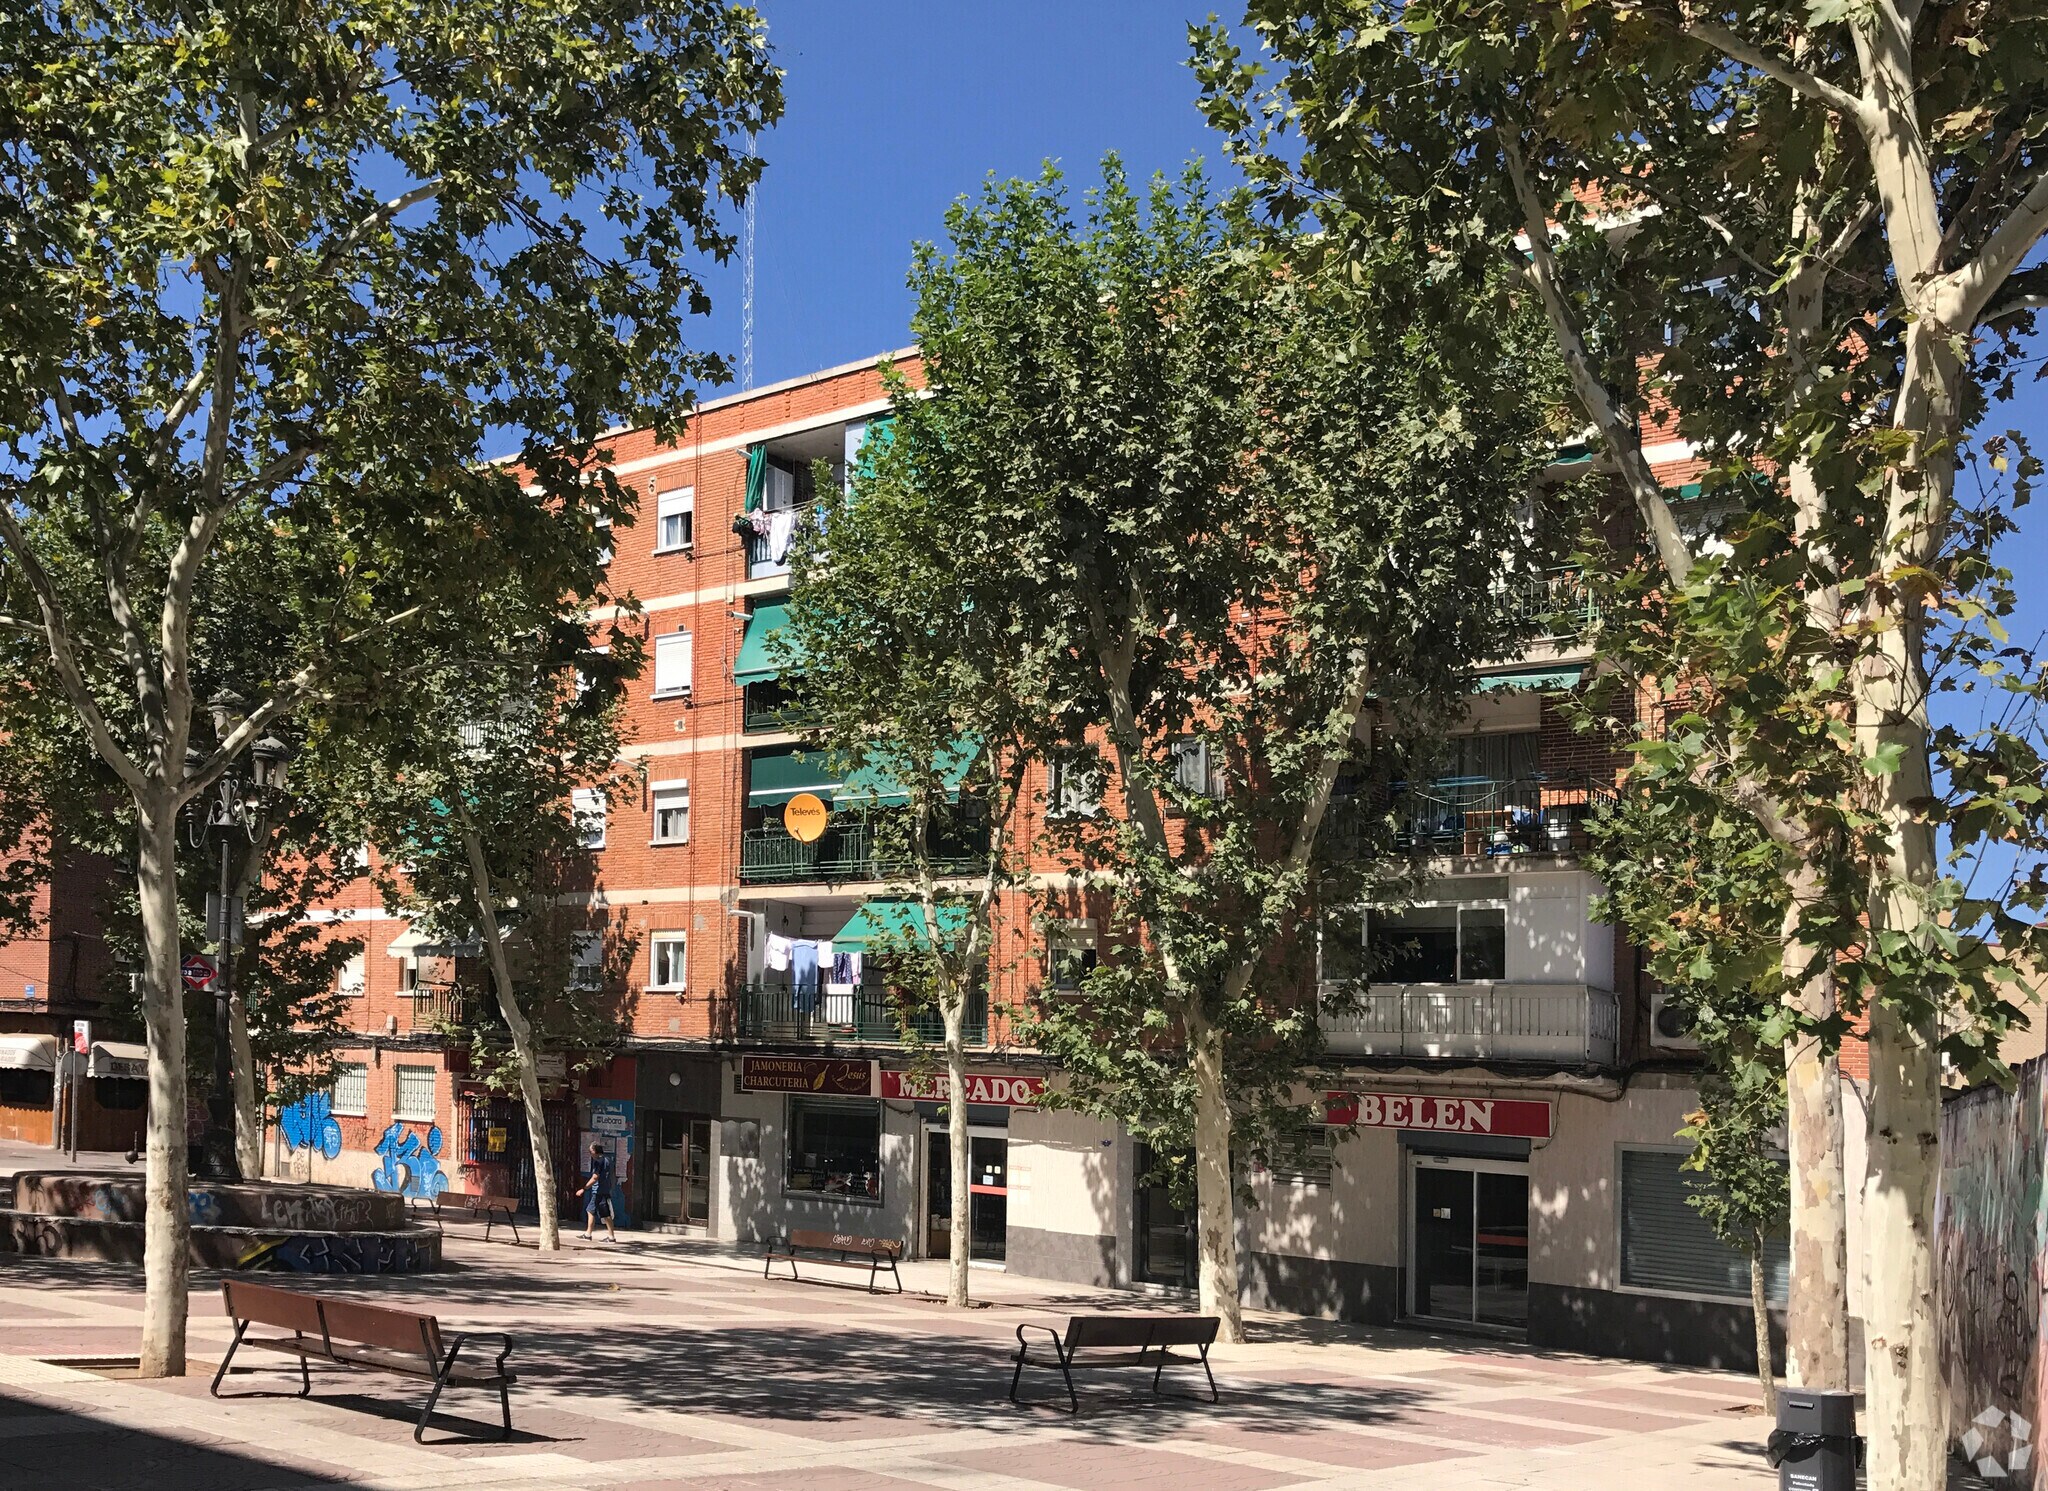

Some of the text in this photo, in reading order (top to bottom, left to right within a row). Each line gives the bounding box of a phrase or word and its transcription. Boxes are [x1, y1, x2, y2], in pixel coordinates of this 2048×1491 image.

[790, 808, 820, 816] Televés
[750, 1060, 803, 1073] JAMONERIA
[836, 1063, 867, 1082] Jesús
[743, 1075, 809, 1088] CHARCUTERIA
[898, 1073, 1031, 1104] MERADO
[1356, 1095, 1495, 1132] BELEN
[601, 1117, 622, 1125] Lebara
